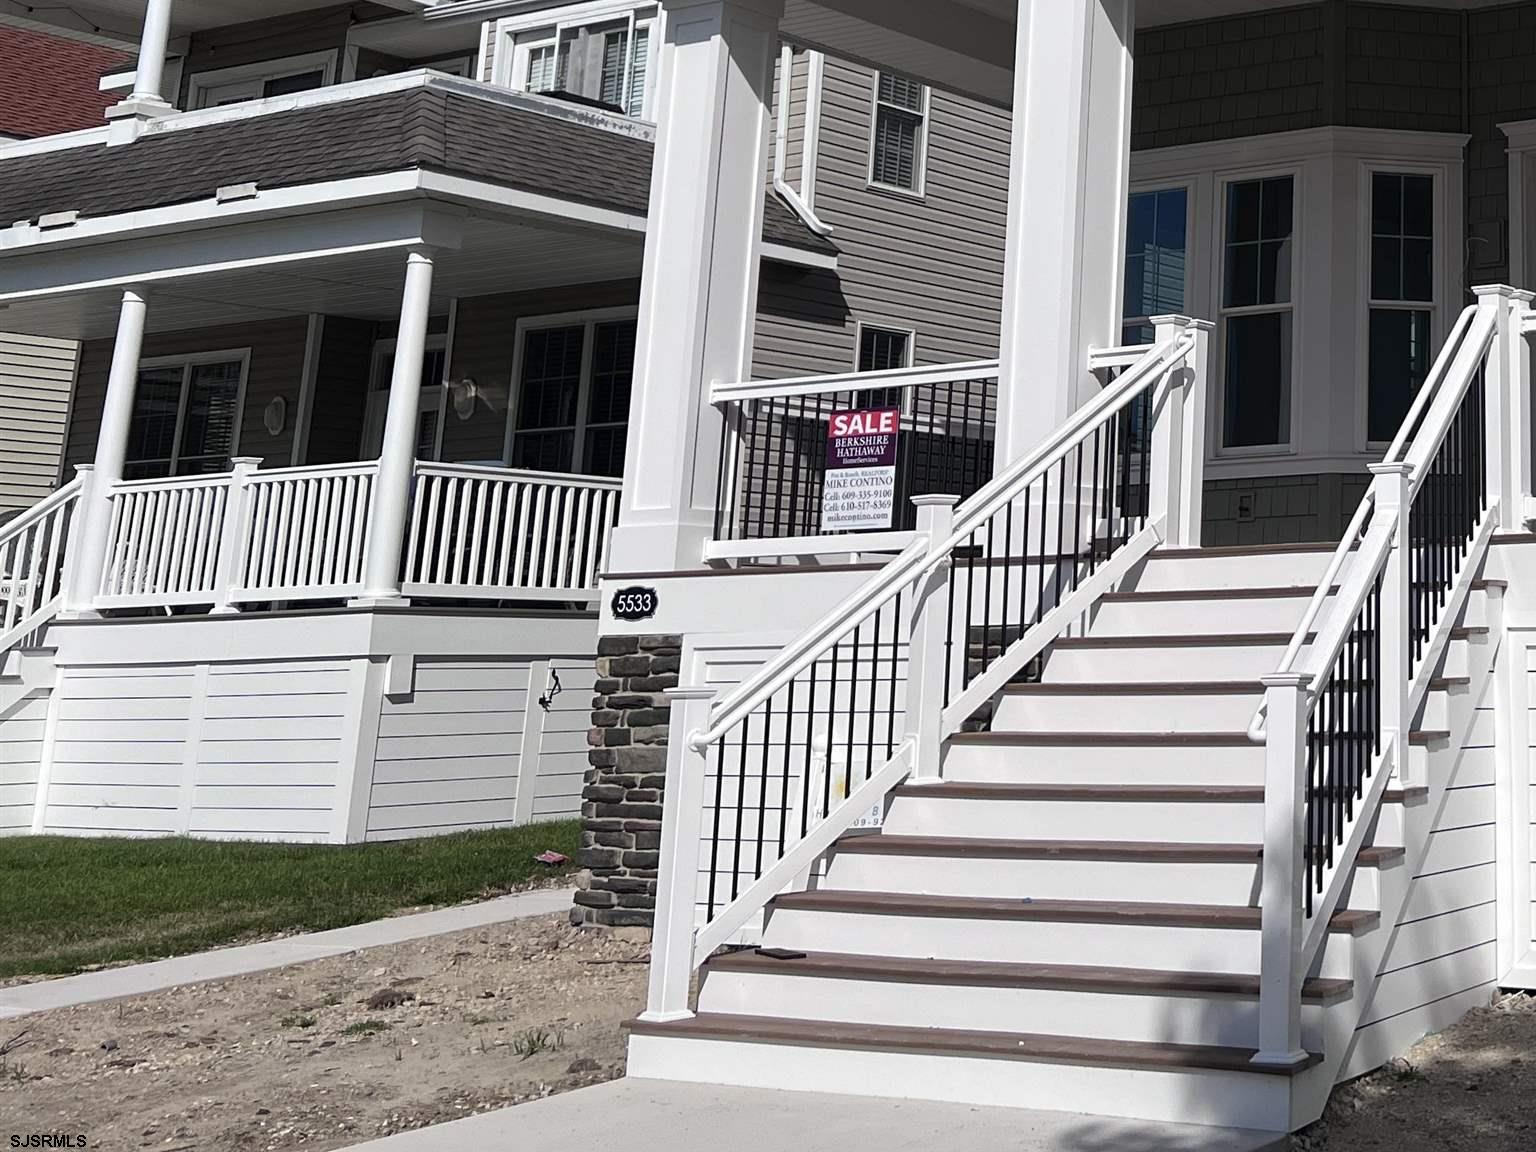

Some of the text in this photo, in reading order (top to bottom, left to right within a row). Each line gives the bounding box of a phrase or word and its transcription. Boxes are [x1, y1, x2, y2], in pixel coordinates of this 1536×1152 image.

[833, 412, 893, 436] SALE
[835, 435, 889, 448] BERKSHIRE
[837, 446, 886, 457] HATHAWAY
[826, 476, 893, 488] MIKE CONTINO
[617, 593, 652, 613] 5533
